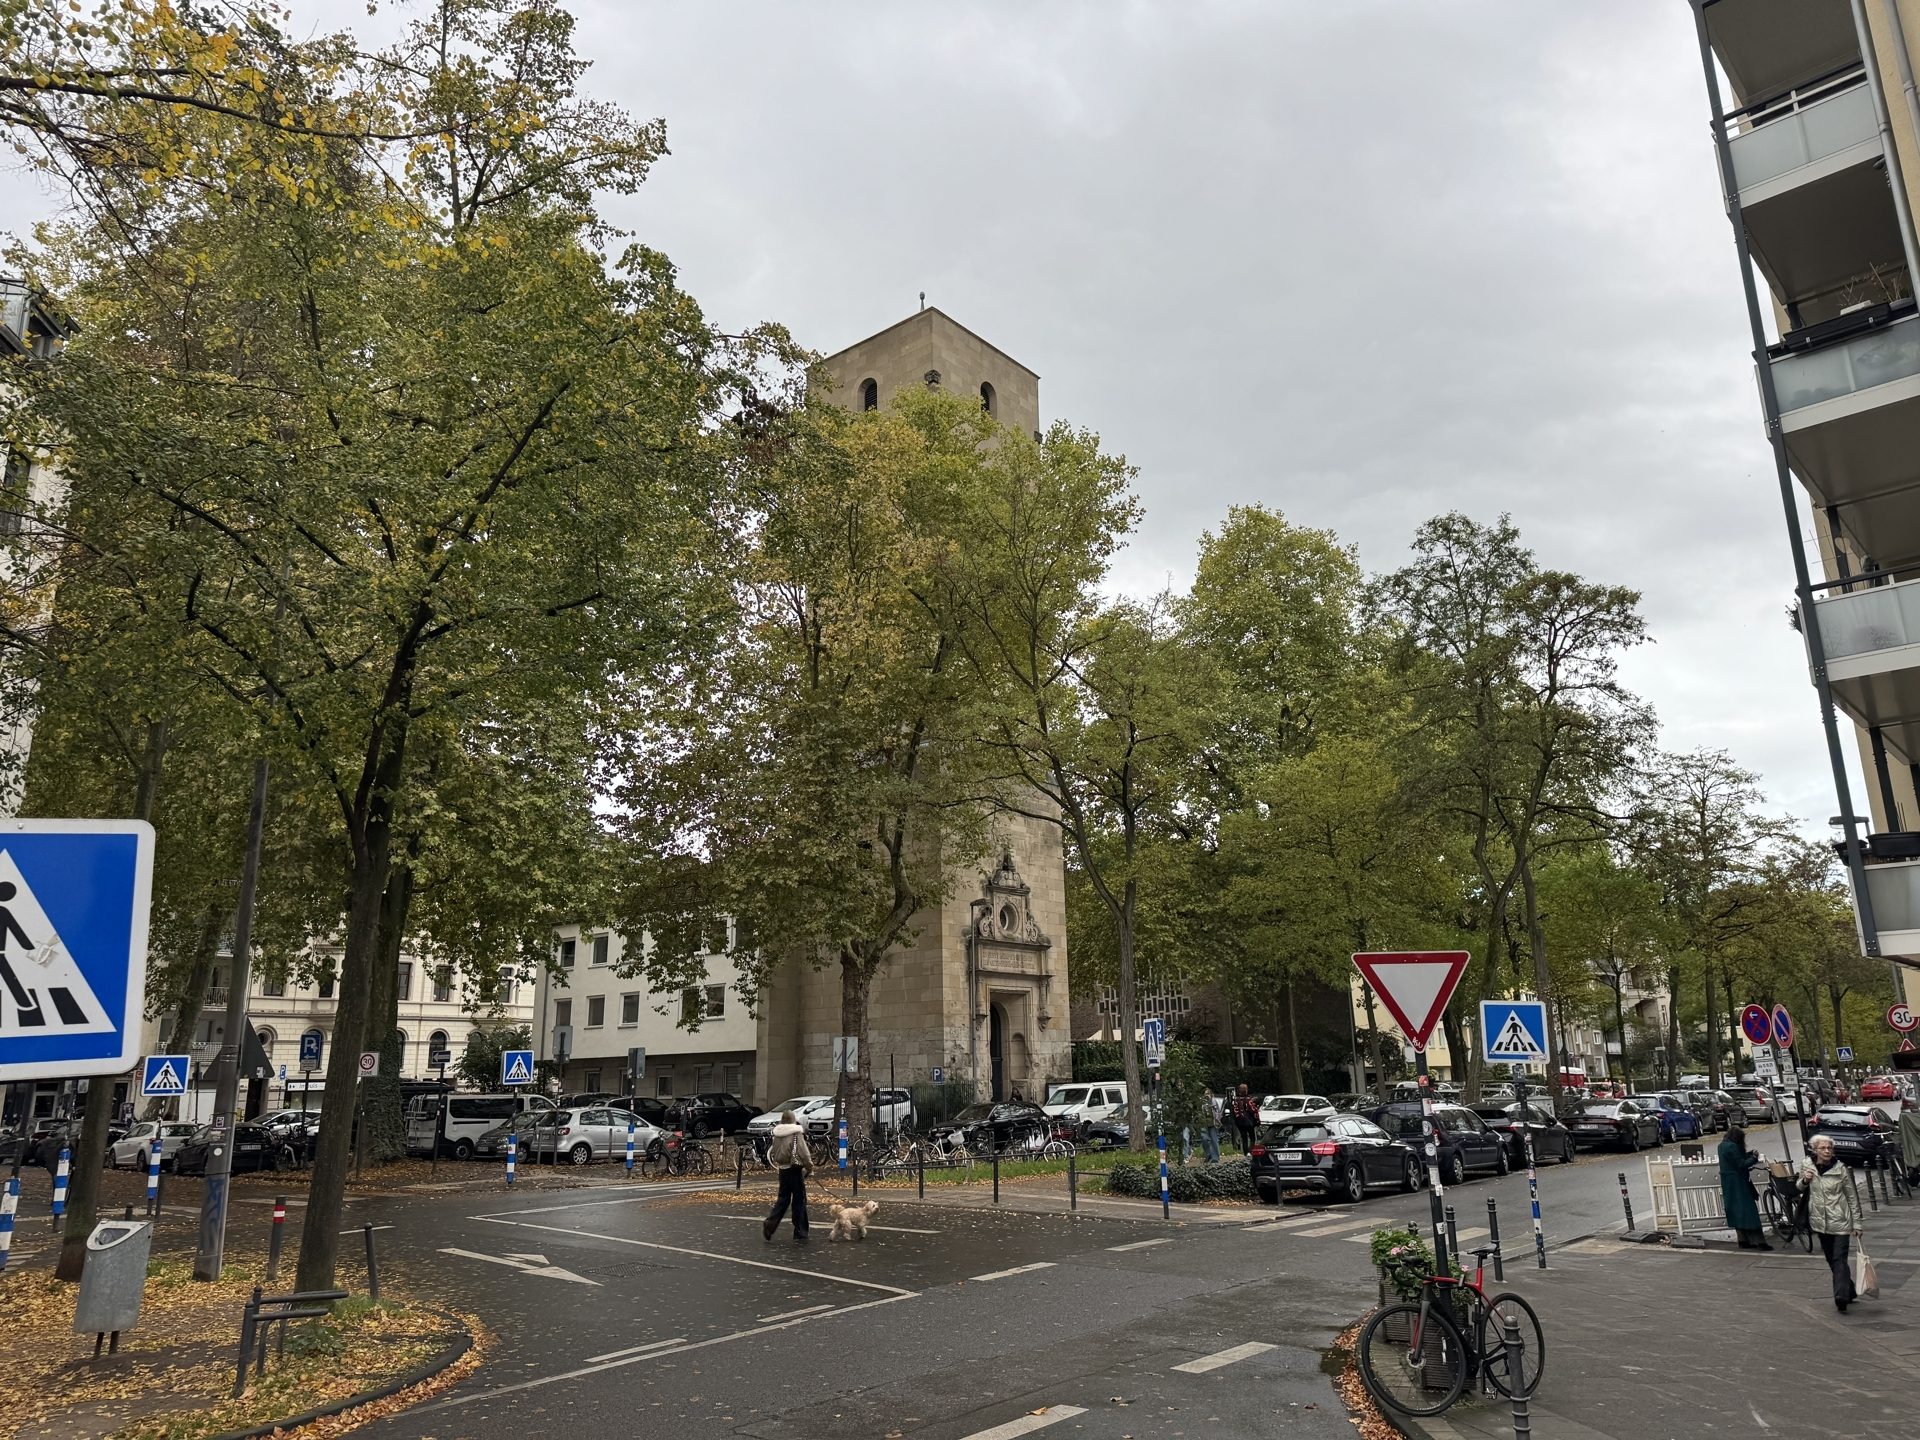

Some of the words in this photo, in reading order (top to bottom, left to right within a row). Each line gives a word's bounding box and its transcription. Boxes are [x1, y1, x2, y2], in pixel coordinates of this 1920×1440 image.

[1894, 1011, 1912, 1024] 30
[362, 1057, 372, 1066] 30
[934, 1068, 941, 1081] P
